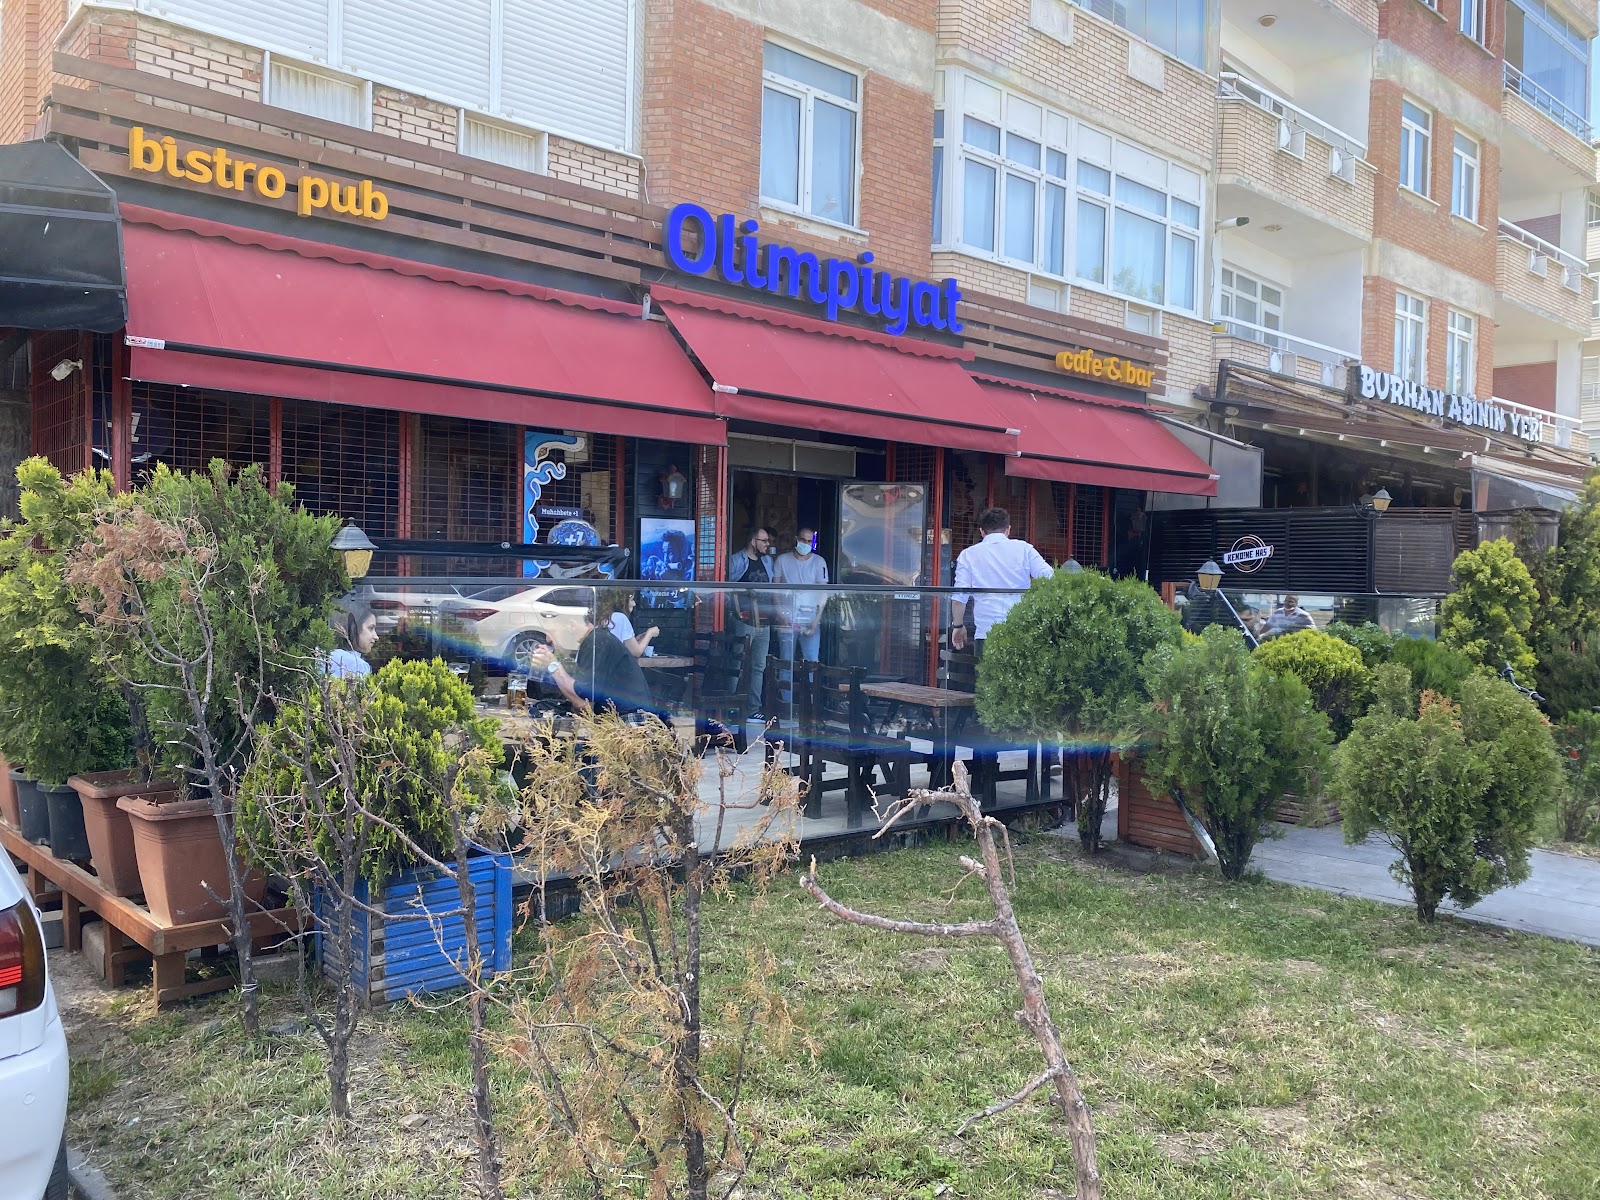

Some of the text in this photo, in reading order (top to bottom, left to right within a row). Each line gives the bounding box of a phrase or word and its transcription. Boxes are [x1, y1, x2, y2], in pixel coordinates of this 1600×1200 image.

[128, 126, 389, 221] bistro pub
[662, 202, 964, 337] Olimpiyat
[1056, 348, 1155, 388] cafe & bar
[1360, 364, 1445, 417] BURHAN
[1255, 548, 1267, 557] HAS
